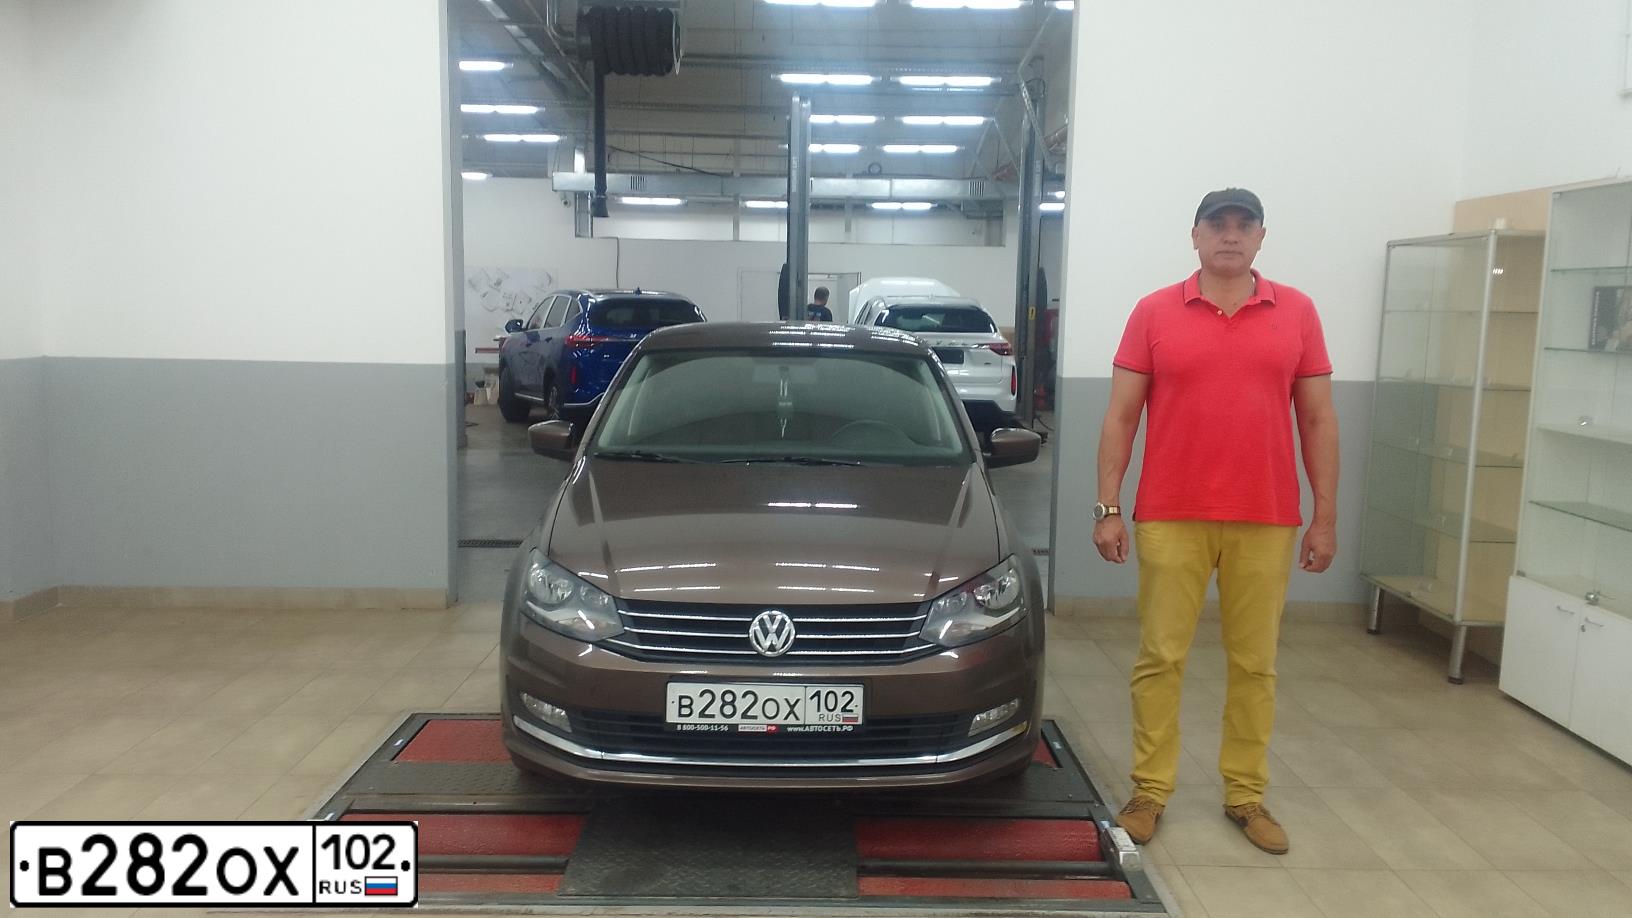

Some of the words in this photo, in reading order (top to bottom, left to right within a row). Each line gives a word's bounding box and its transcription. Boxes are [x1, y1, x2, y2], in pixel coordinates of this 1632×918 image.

[677, 688, 801, 721] В282ОХ
[809, 689, 855, 713] 102
[818, 713, 842, 723] RUS
